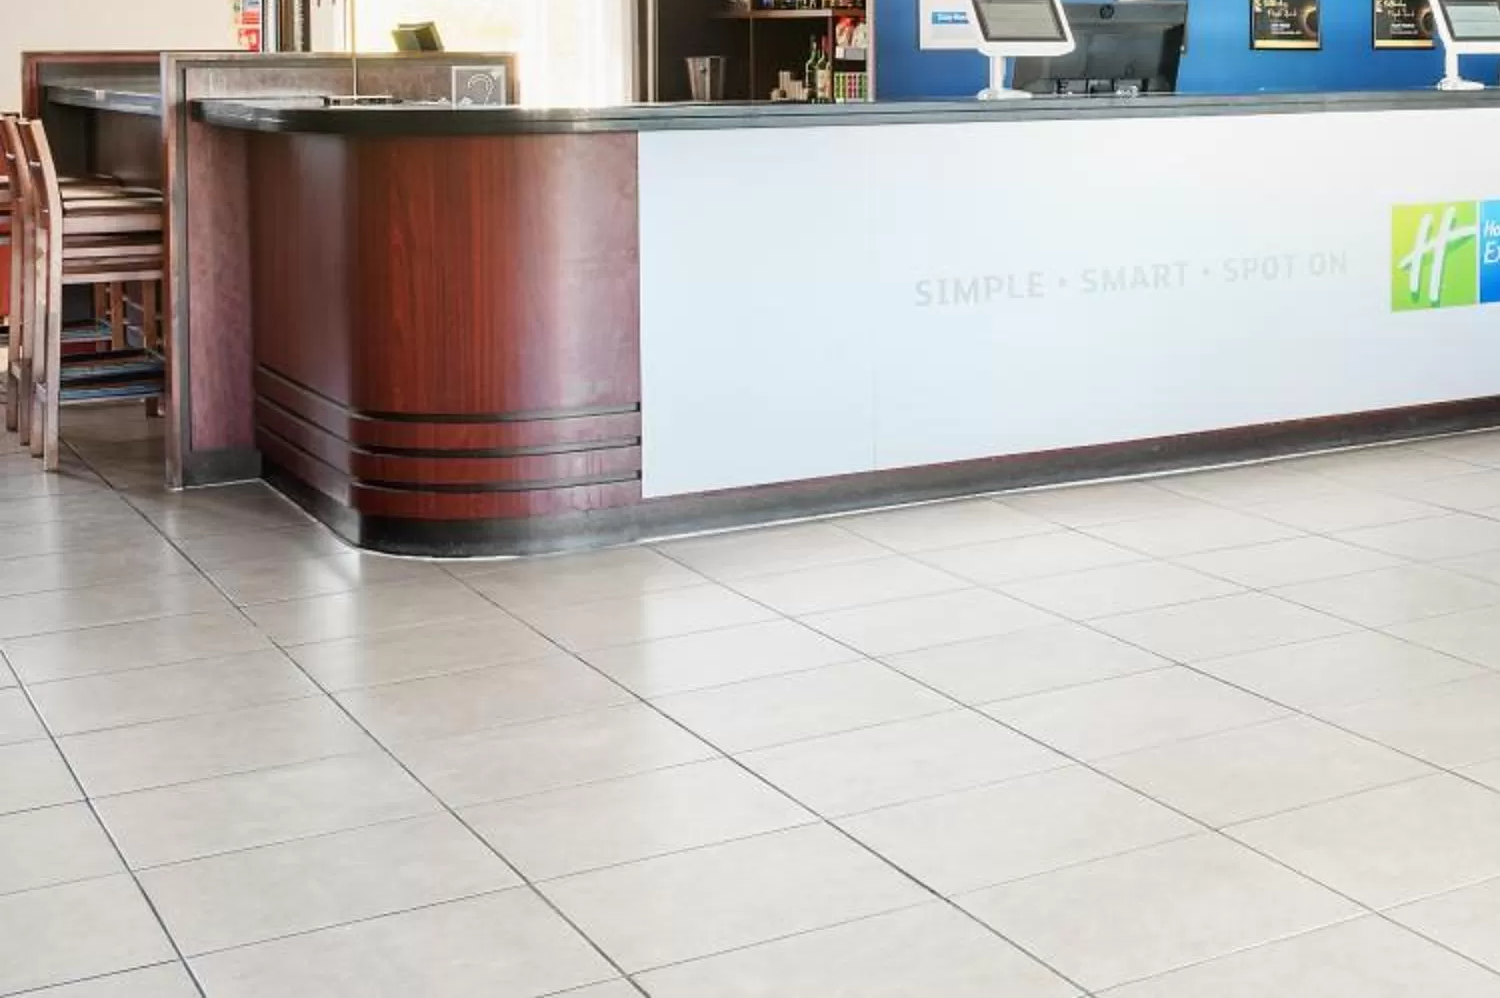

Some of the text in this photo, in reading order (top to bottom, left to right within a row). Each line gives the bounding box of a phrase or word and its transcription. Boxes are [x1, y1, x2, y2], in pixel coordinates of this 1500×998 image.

[914, 249, 1348, 307] SIMPLE SMART SPOT ON
